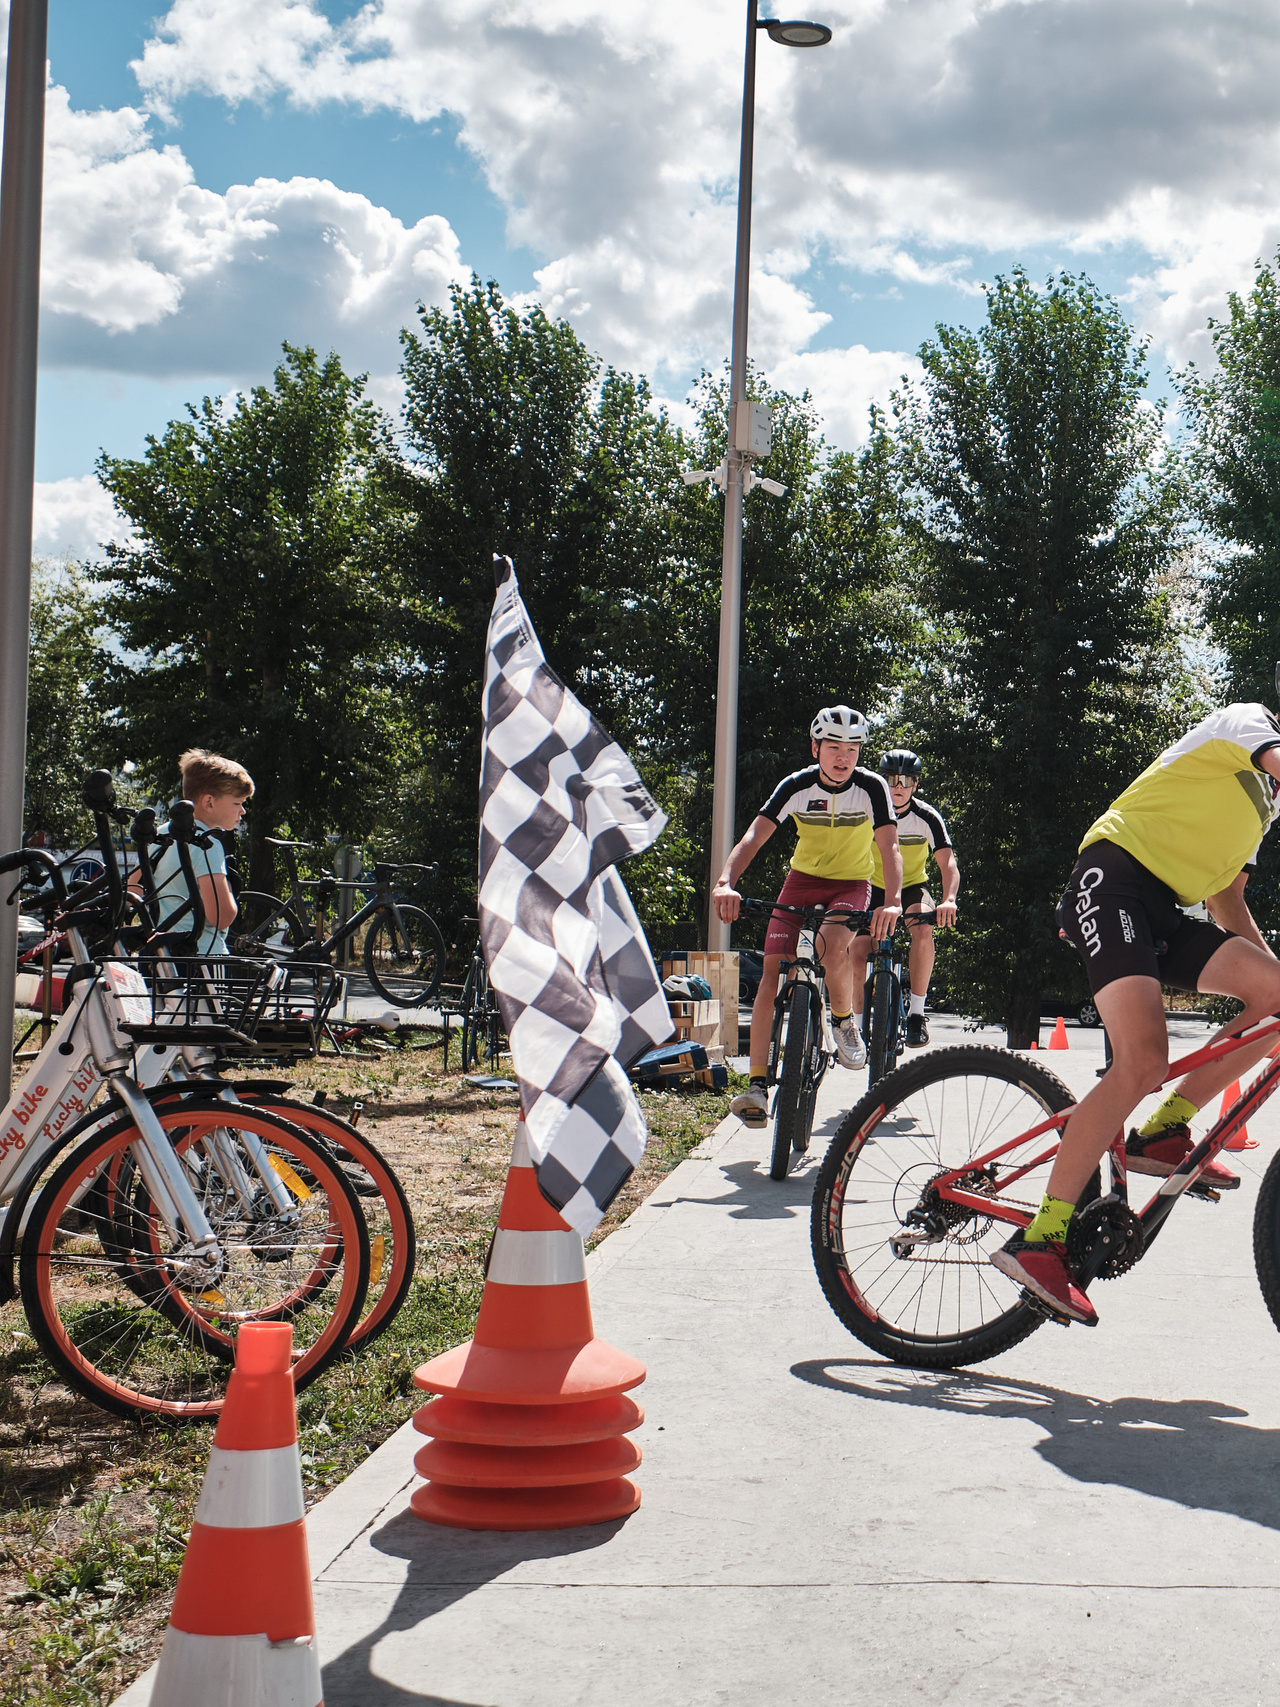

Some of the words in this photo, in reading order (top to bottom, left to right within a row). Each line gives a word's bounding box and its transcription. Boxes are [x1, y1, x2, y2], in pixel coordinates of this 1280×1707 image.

[1075, 867, 1104, 958] Crelan
[11, 1084, 49, 1126] bike
[42, 1094, 84, 1141] Lucky
[72, 1061, 100, 1094] bik
